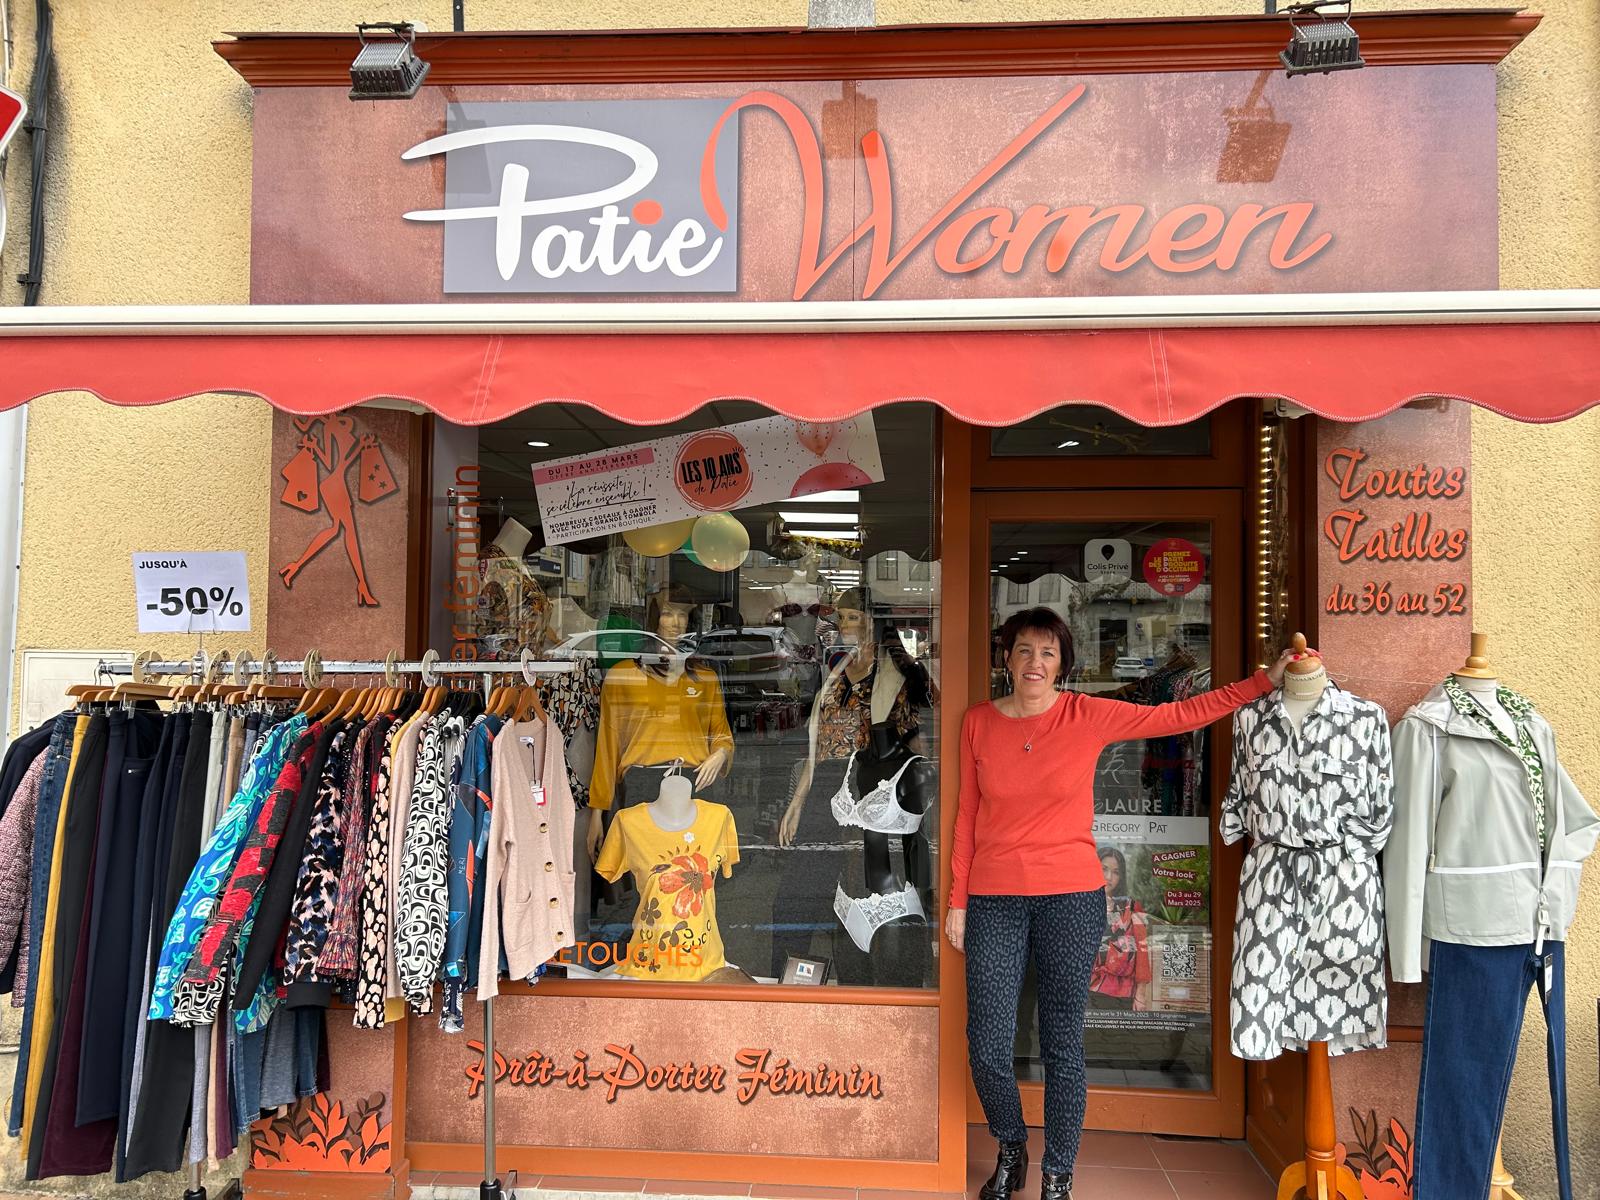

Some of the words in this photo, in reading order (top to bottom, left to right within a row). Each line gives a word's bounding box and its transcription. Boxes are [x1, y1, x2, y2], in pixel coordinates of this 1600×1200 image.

[402, 125, 724, 281] Patie
[700, 83, 1333, 300] Women
[612, 454, 638, 464] MARS
[680, 460, 702, 484] LES
[702, 457, 716, 480] 10
[719, 452, 742, 476] ANS
[1325, 447, 1465, 501] Toutes
[550, 518, 587, 530] NOMBREUX
[588, 512, 621, 522] CADEAUX
[629, 504, 657, 514] GAGNER
[571, 522, 590, 531] NOTRE
[595, 516, 622, 526] GRANDE
[624, 510, 657, 520] TOMBOLA
[1324, 509, 1466, 561] Tailles
[139, 558, 188, 569] JUSQU'À
[1108, 562, 1129, 570] Privé
[146, 587, 244, 616] -50%
[1326, 584, 1356, 612] du
[1361, 582, 1392, 613] 36
[1396, 593, 1427, 613] au
[1432, 583, 1465, 614] 52
[1105, 798, 1162, 813] LAURE
[1091, 820, 1140, 832] GREGORY
[1161, 850, 1196, 861] GAGNER
[1152, 868, 1175, 877] Votre
[466, 1040, 724, 1102] Prêt-à-Porter
[734, 1047, 882, 1104] Féminin
